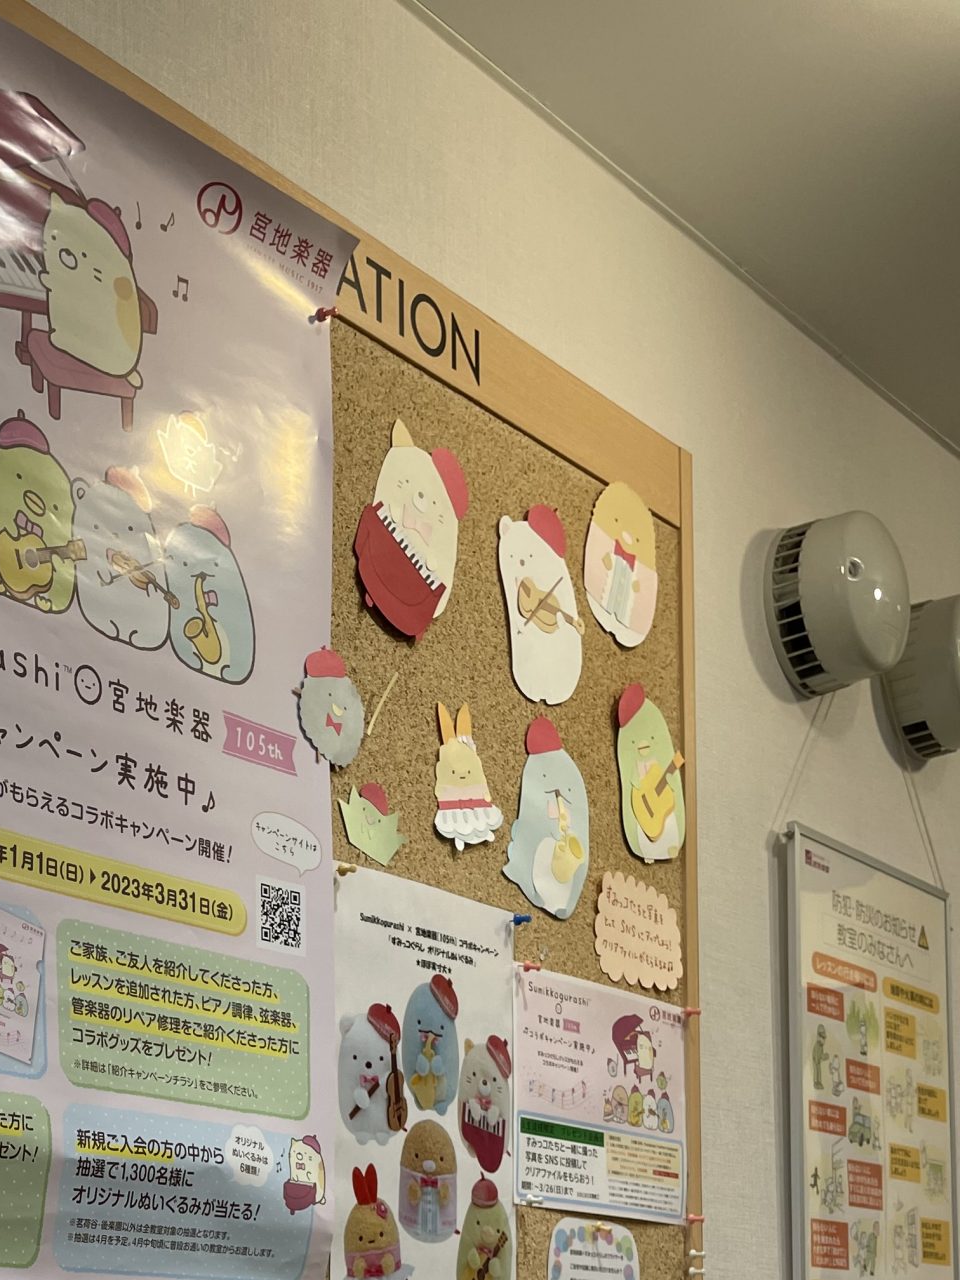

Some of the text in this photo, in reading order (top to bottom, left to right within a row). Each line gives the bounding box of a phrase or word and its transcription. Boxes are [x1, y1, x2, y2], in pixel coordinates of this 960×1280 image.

[249, 211, 334, 280] 宮地楽器
[279, 263, 305, 283] MUSIC
[307, 279, 324, 294] 1917
[109, 680, 213, 743] 宮地楽器
[234, 726, 284, 761] 105th
[255, 821, 317, 852] キャンペーンサイトは
[275, 842, 296, 857] こちら
[70, 939, 279, 1000] ご家族、ご友人を紹介してくださった方、
[70, 968, 297, 1029] レッスンを追加された方、ピアノ調律、弦楽器、
[528, 981, 589, 1007] Sumikkogurashi
[71, 996, 300, 1055] 管楽器のリペア修理をご紹介くださった方に
[72, 1027, 213, 1067] コラボグッズをプレゼント!
[76, 1128, 225, 1165] 新規ご入会の方の中から
[232, 1148, 269, 1165] ぬいぐるみは
[234, 1134, 265, 1151] オリジナル
[75, 1156, 194, 1187] 抽選で1,300名様に
[240, 1162, 261, 1177] 6種類!
[72, 1185, 261, 1222] オリジナルぬいぐるみが当たる!
